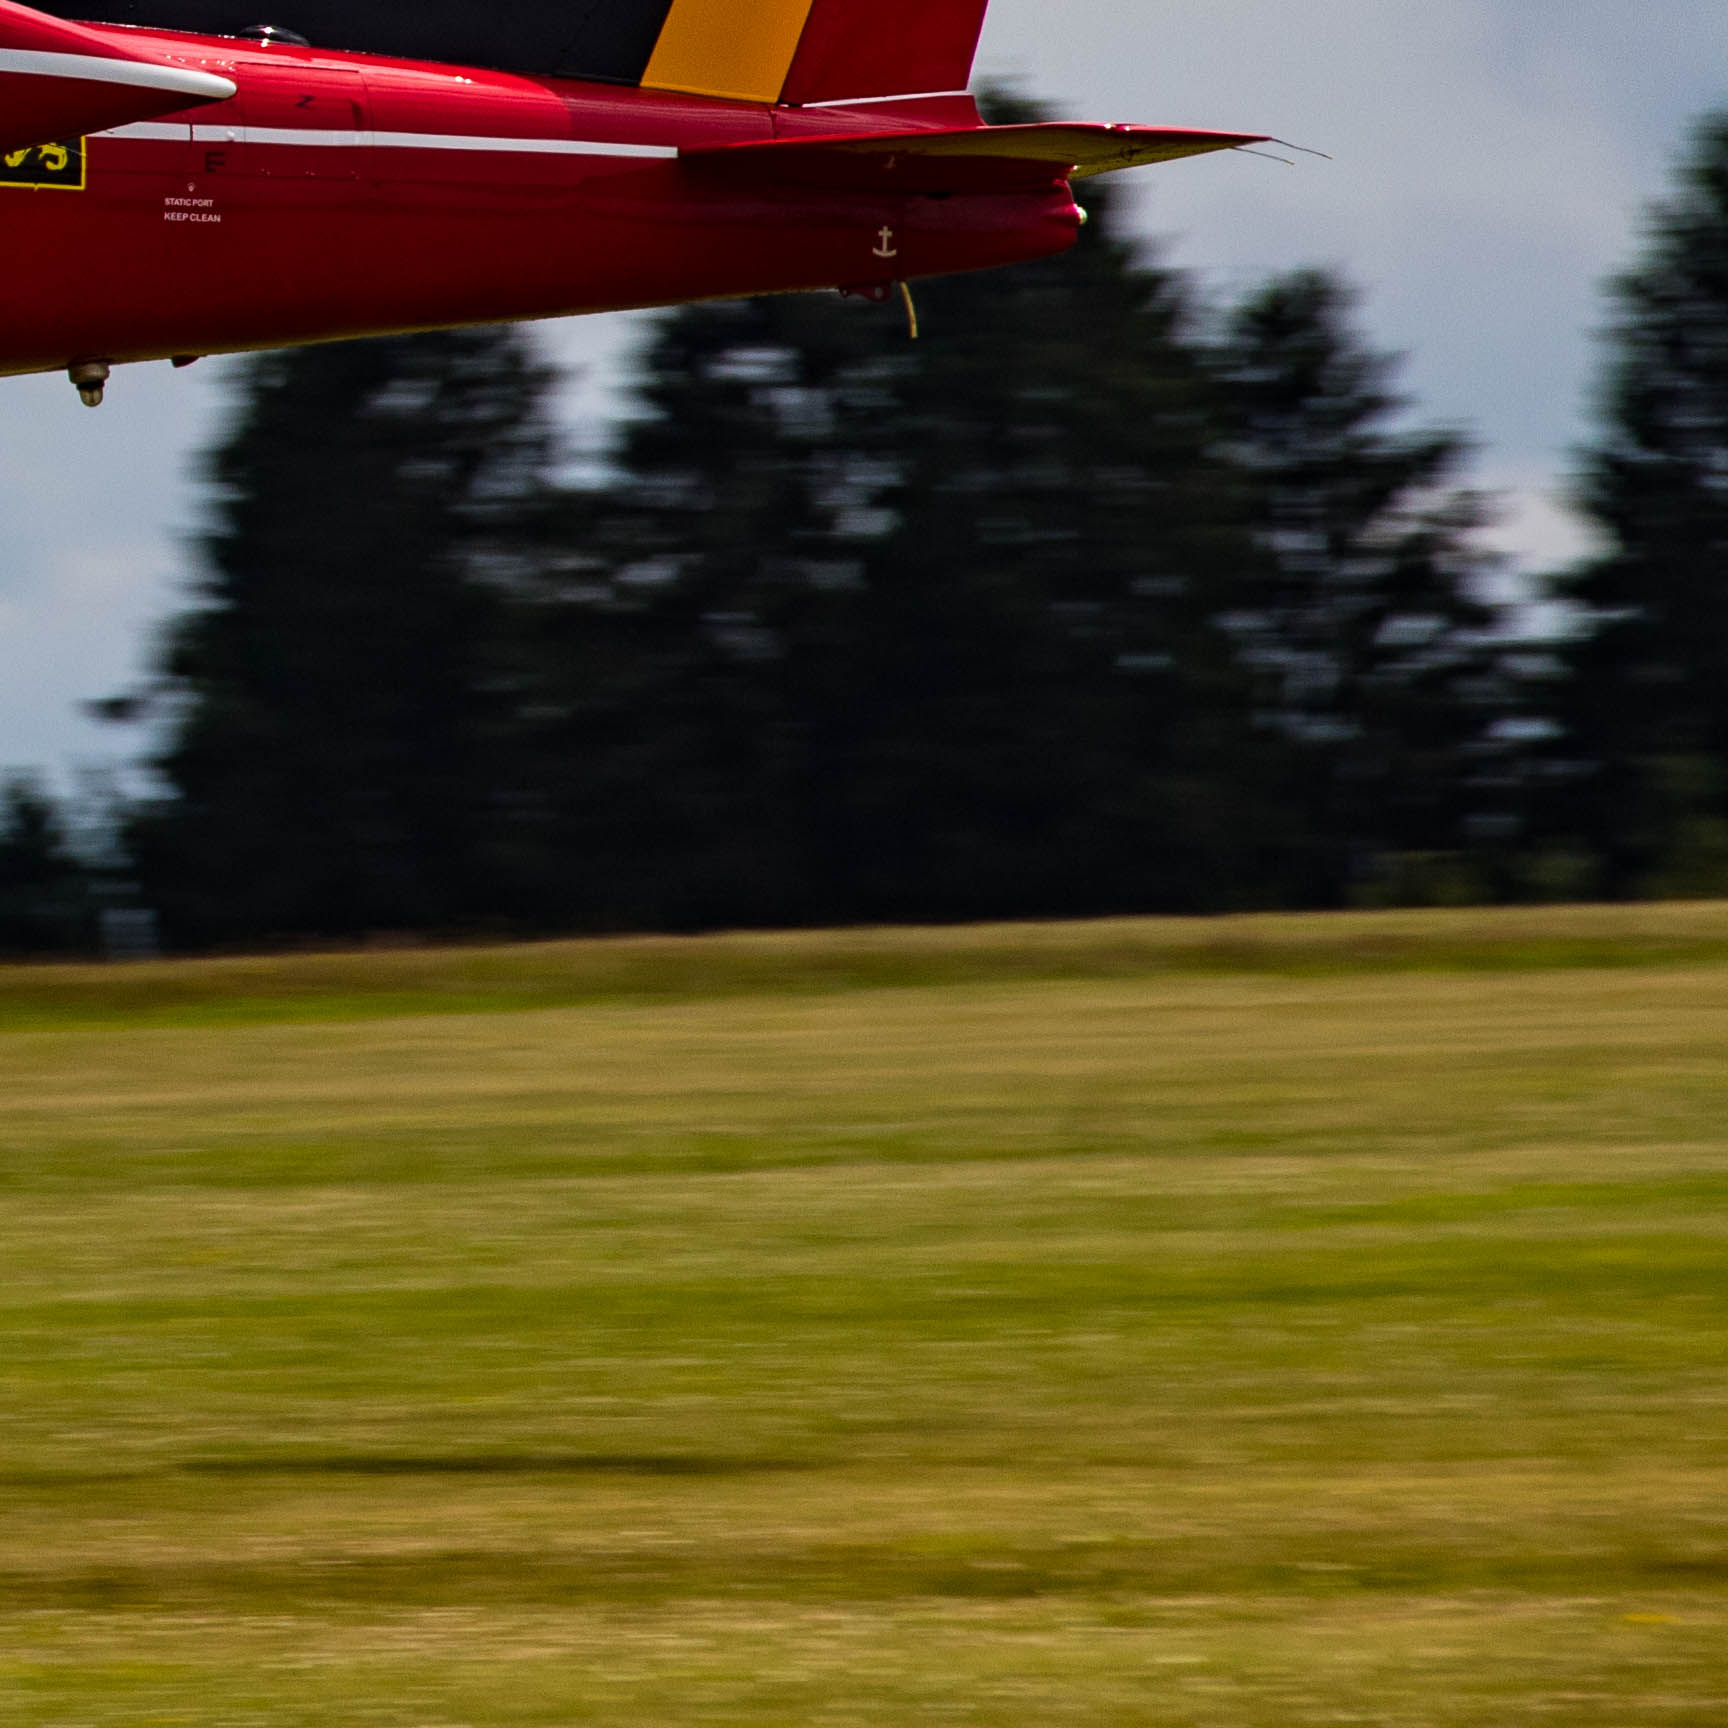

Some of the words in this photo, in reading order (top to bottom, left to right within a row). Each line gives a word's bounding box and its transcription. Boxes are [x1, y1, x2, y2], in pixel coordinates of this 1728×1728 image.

[165, 198, 191, 206] STATIC
[193, 199, 213, 207] PORT
[165, 212, 189, 221] KEEP
[190, 213, 221, 222] CLEAN
